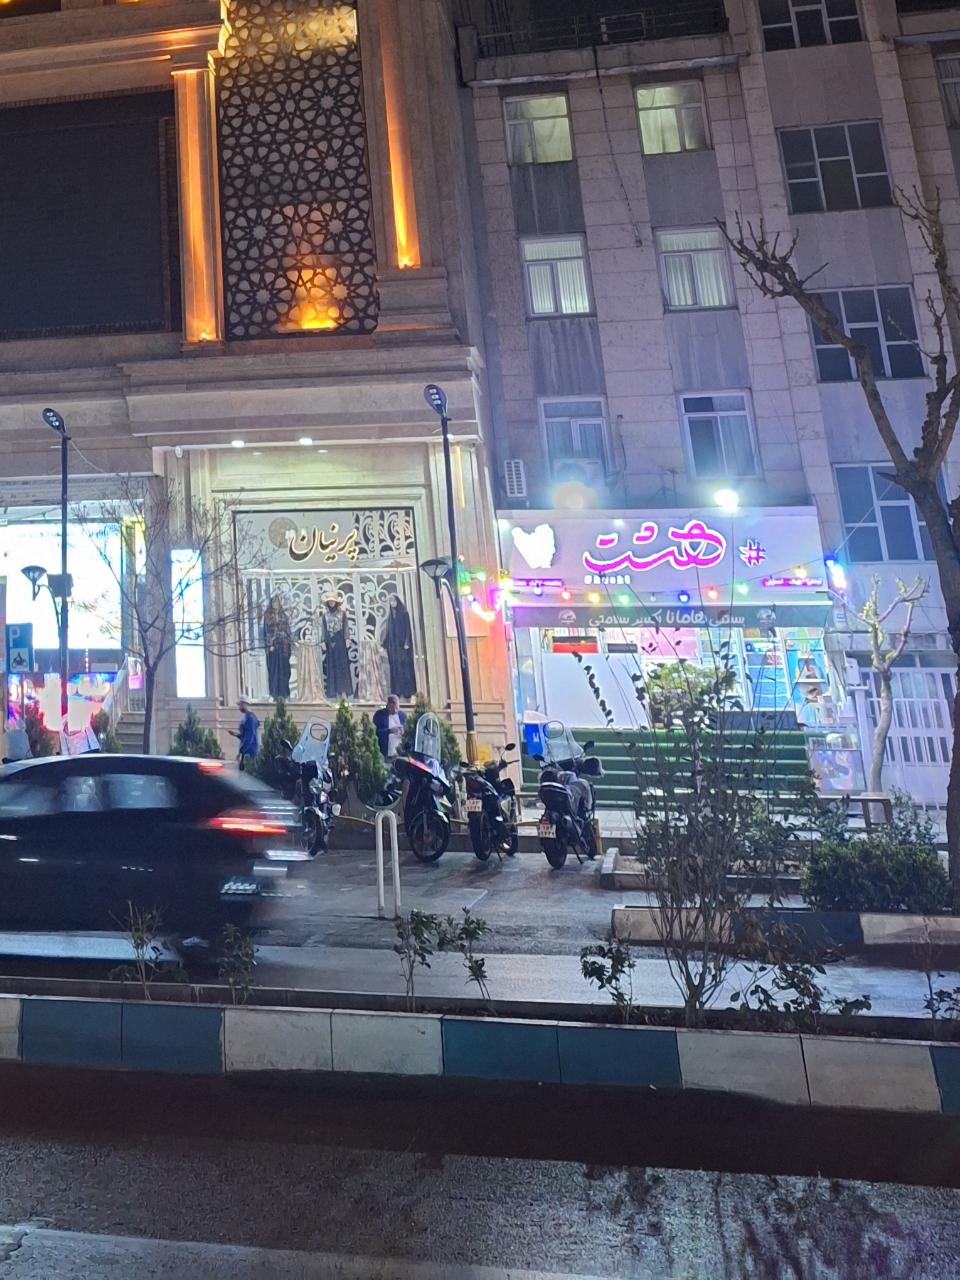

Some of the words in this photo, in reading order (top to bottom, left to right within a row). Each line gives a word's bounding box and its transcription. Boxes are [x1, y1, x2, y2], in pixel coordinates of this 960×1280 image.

[287, 522, 358, 563] پرنیان
[583, 520, 726, 572] هشت
[9, 626, 20, 648] P
